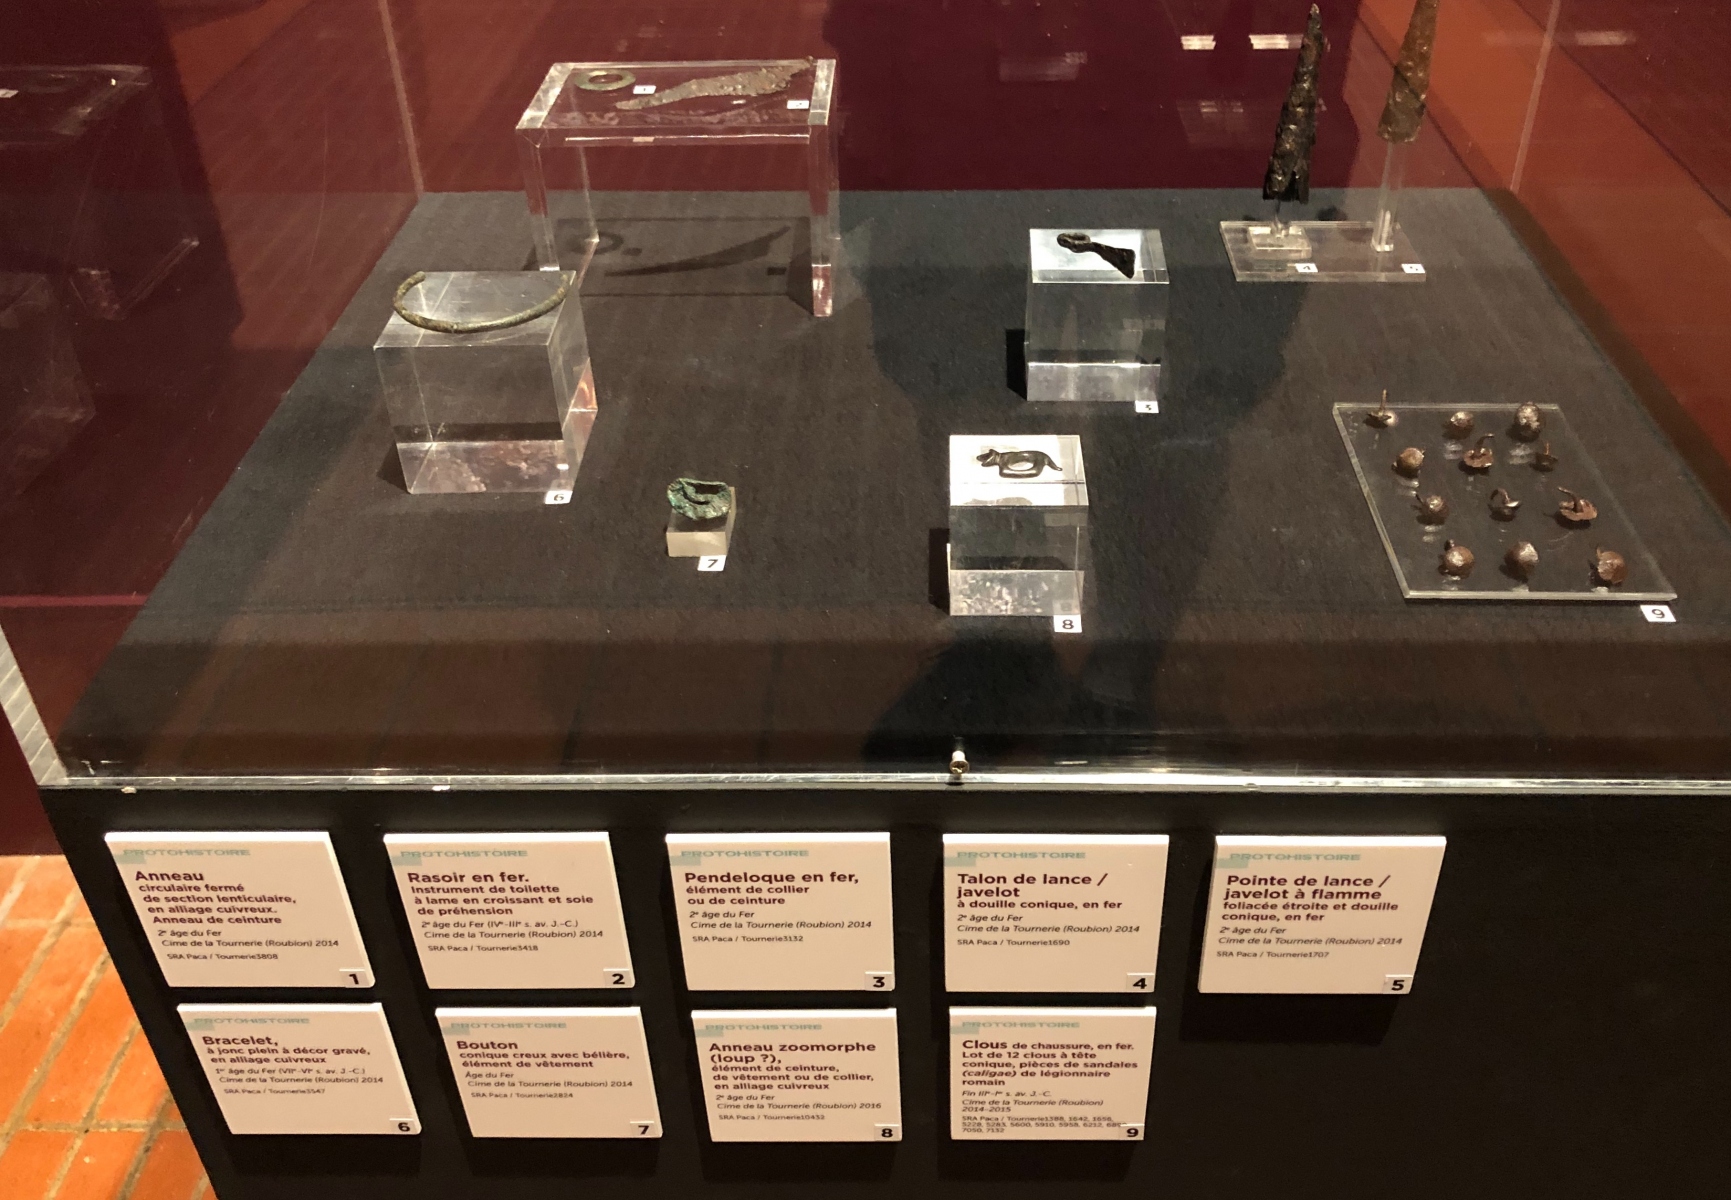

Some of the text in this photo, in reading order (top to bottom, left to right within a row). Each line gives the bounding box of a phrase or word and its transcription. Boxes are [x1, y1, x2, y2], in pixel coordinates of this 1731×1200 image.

[553, 494, 564, 502] 6
[707, 559, 718, 568] 7
[1651, 608, 1665, 619] 9
[1062, 619, 1074, 630] 8
[135, 871, 204, 881] Anneau
[407, 872, 465, 883] Rasoir
[499, 872, 529, 882] fer.
[685, 872, 858, 884] Pendeloque en fer,
[957, 873, 1007, 884] Talon
[1013, 874, 1036, 884] de
[1043, 874, 1092, 884] lance
[1227, 875, 1287, 886] Pointe
[1294, 876, 1317, 886] de
[1324, 876, 1373, 886] lance
[139, 884, 244, 892] circulaire fermé
[489, 885, 506, 893] de
[510, 885, 559, 893] toilette
[686, 886, 741, 894] élément
[767, 885, 809, 893] collier
[957, 887, 1020, 899] javelot
[1223, 887, 1381, 900] javelot à flamme
[216, 895, 296, 904] lenticulaire,
[415, 896, 422, 904] à
[425, 896, 458, 904] lame
[483, 896, 544, 904] croissant
[566, 895, 593, 903] soie
[168, 905, 212, 914] alliage
[957, 900, 965, 908] à
[969, 900, 1015, 908] douille
[1020, 901, 1078, 910] conique,
[1223, 902, 1278, 910] foliacée
[1282, 902, 1328, 910] étroite
[1351, 902, 1398, 910] douille
[418, 907, 513, 916] de préhension
[1222, 913, 1280, 922] conique,
[1306, 913, 1324, 921] fer
[1063, 925, 1112, 933] (Roubion)
[349, 973, 359, 985] 1
[612, 973, 625, 985] 2
[873, 976, 885, 988] 3
[1133, 978, 1147, 989] 4
[1391, 979, 1405, 991] 5
[202, 1036, 278, 1046] Bracelet,
[457, 1041, 518, 1049] Bouton
[962, 1040, 1007, 1049] Clous
[1031, 1042, 1094, 1051] chaussure,
[217, 1047, 244, 1055] jonc
[248, 1047, 279, 1055] plein
[332, 1047, 370, 1055] gravé,
[709, 1042, 876, 1053] Anneau zoomorphe
[230, 1056, 270, 1064] alliage
[459, 1052, 509, 1060] conique
[583, 1051, 629, 1059] bélière,
[711, 1054, 781, 1064] (loup ?),
[962, 1061, 1015, 1069] conique,
[1019, 1061, 1059, 1069] pièces
[465, 1071, 483, 1079] Âge
[962, 1070, 1017, 1078] (caligae)
[1040, 1070, 1110, 1078] légionnaire
[733, 1083, 773, 1091] alliage
[398, 1122, 410, 1132] 6
[638, 1124, 650, 1135] 7
[1124, 1127, 1139, 1137] 9
[881, 1127, 893, 1138] 8
